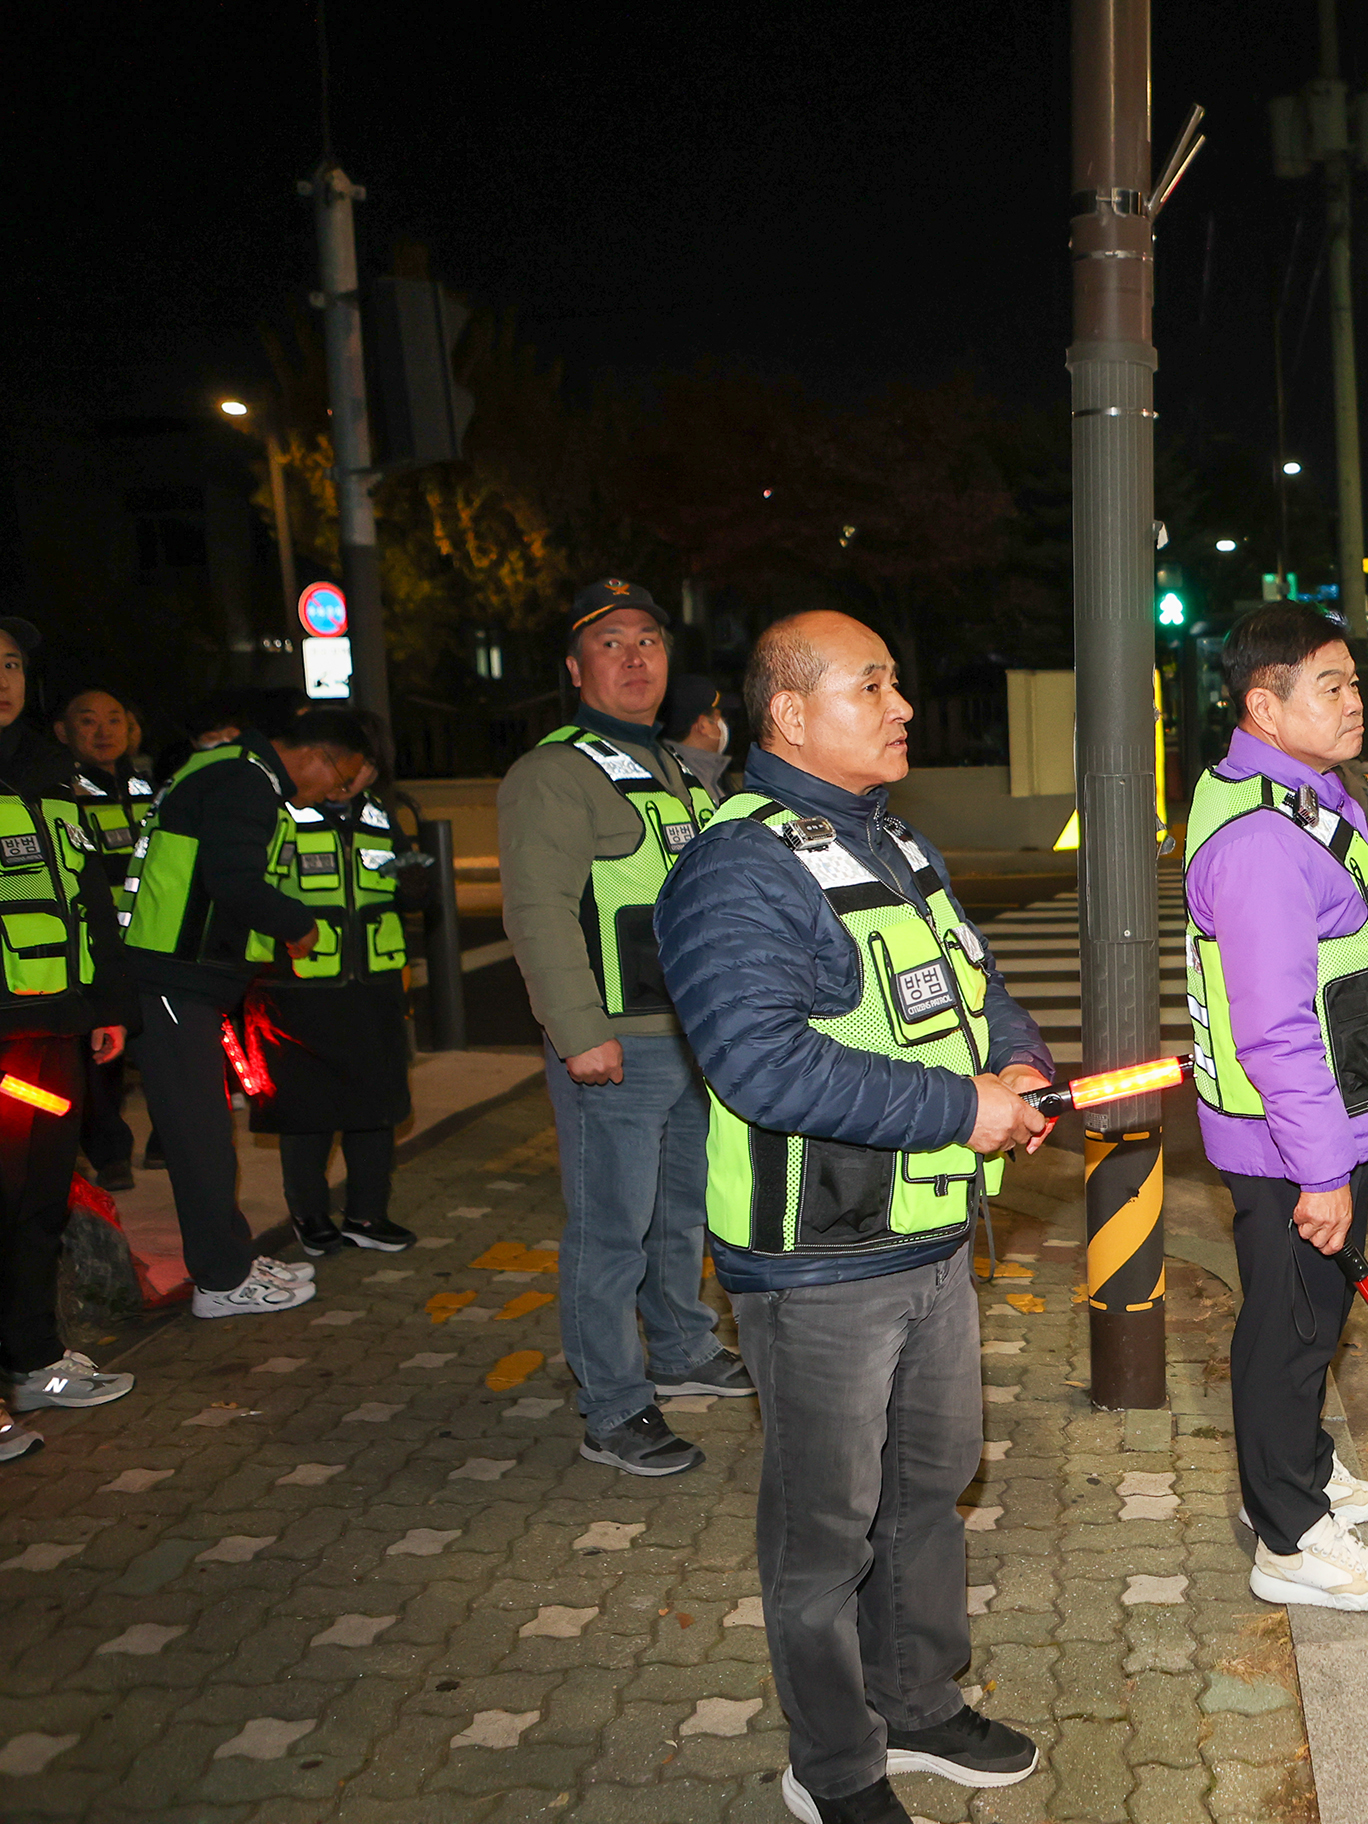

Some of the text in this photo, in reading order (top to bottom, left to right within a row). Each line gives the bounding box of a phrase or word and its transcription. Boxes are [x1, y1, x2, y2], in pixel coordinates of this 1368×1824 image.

[669, 825, 693, 842] 방범
[5, 837, 36, 855] 방범
[904, 967, 942, 1000] 방범
[907, 994, 953, 1015] CITIZENS PATROL
